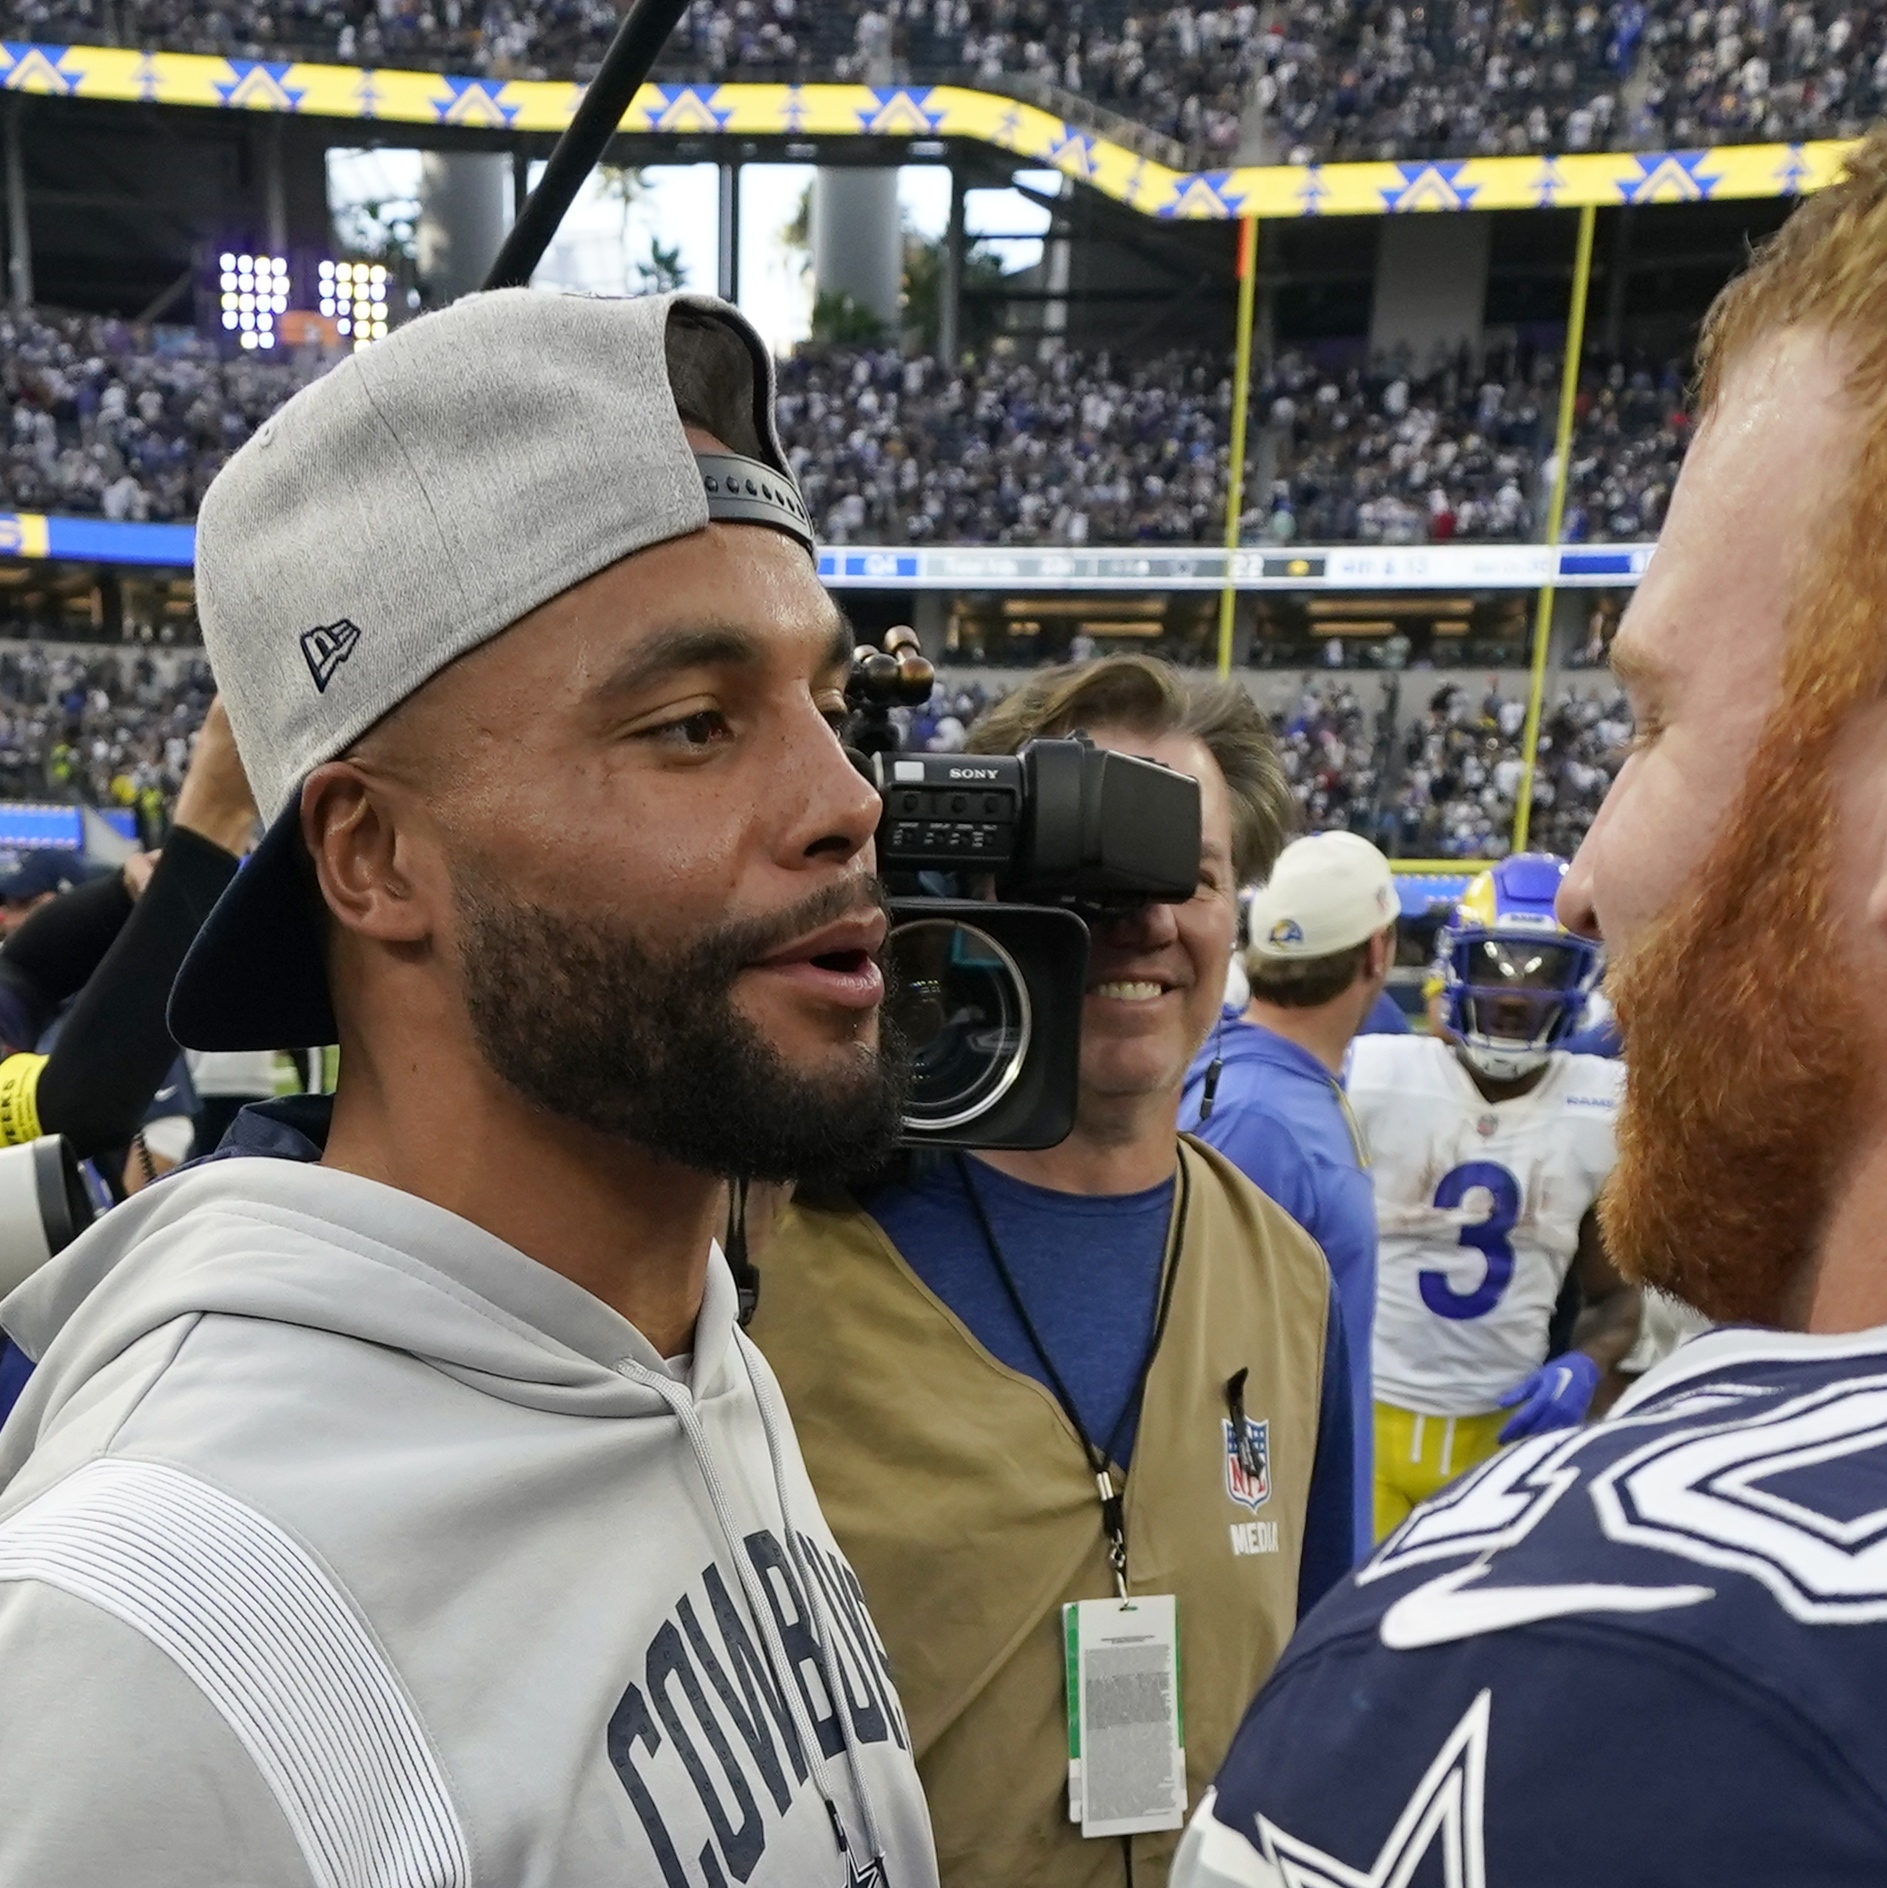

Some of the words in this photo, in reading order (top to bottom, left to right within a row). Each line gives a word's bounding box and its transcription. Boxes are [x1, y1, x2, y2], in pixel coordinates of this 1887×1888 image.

[949, 768, 999, 779] SONY
[1419, 1160, 1522, 1321] 3
[1229, 1520, 1280, 1556] MEDIA
